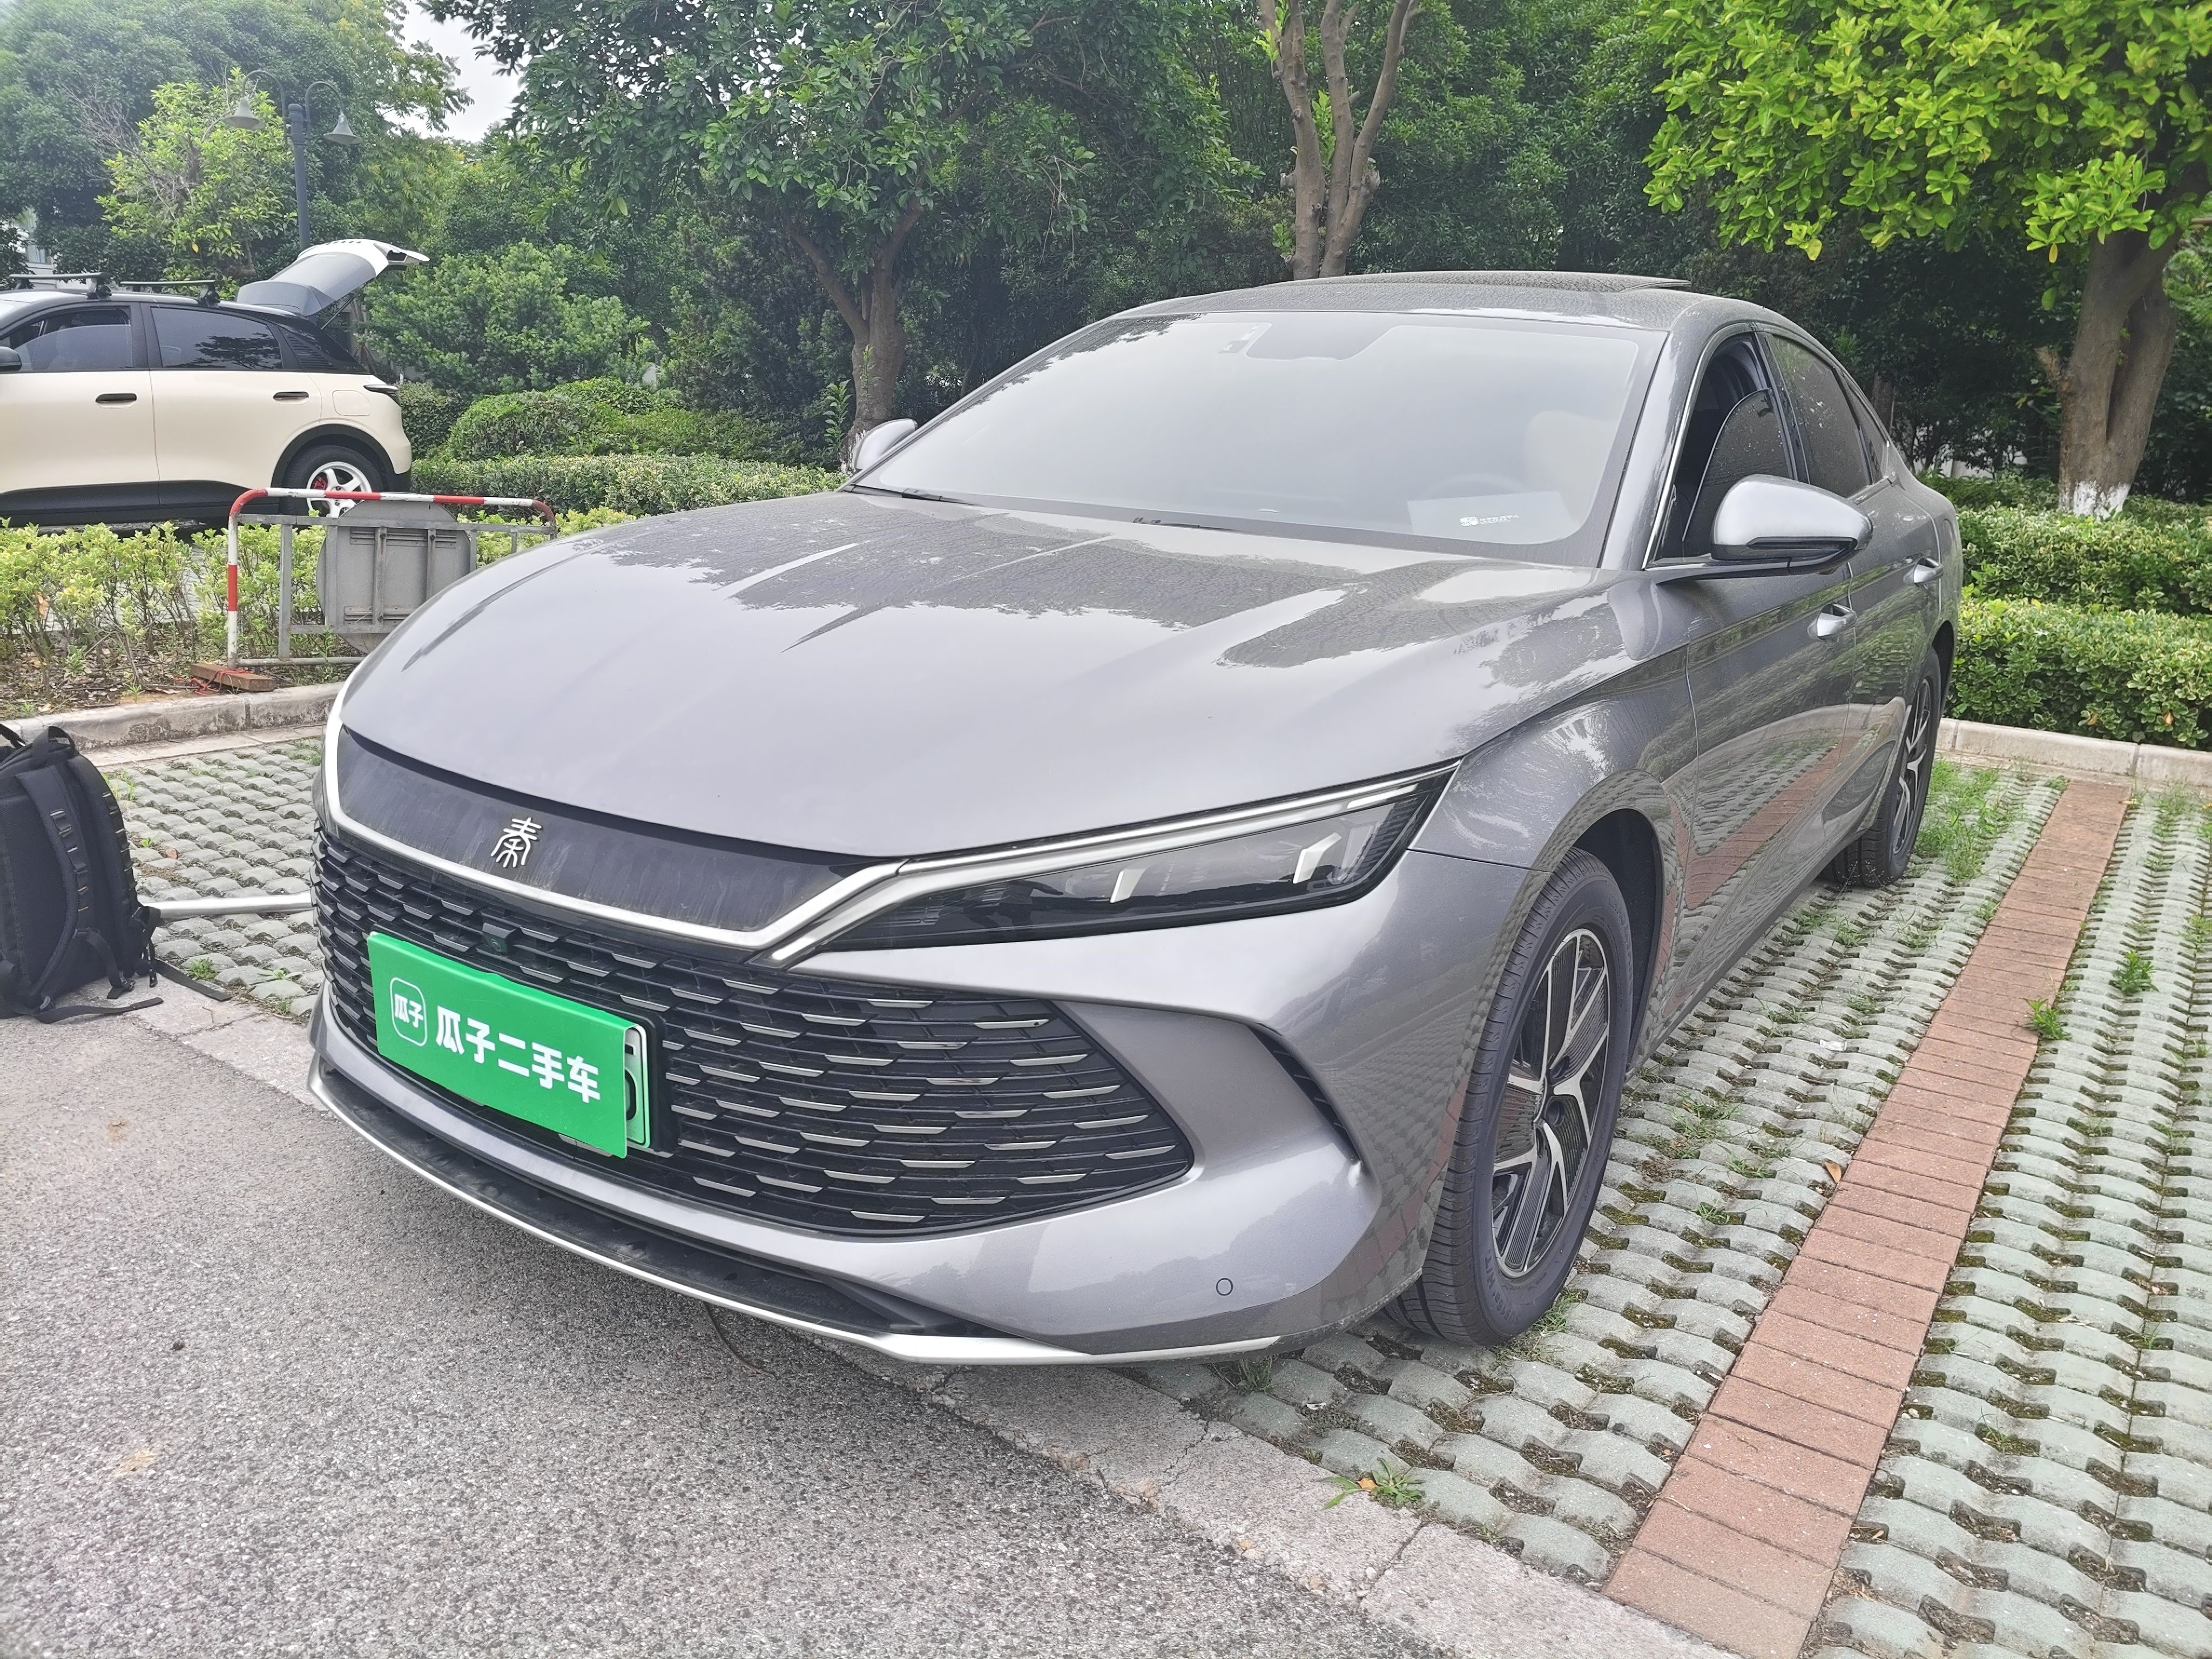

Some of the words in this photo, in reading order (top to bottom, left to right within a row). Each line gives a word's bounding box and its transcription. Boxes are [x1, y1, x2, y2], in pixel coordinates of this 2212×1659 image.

[490, 817, 542, 868] 秦
[395, 993, 423, 1028] 瓜子
[436, 1005, 601, 1103] 瓜子二手车
